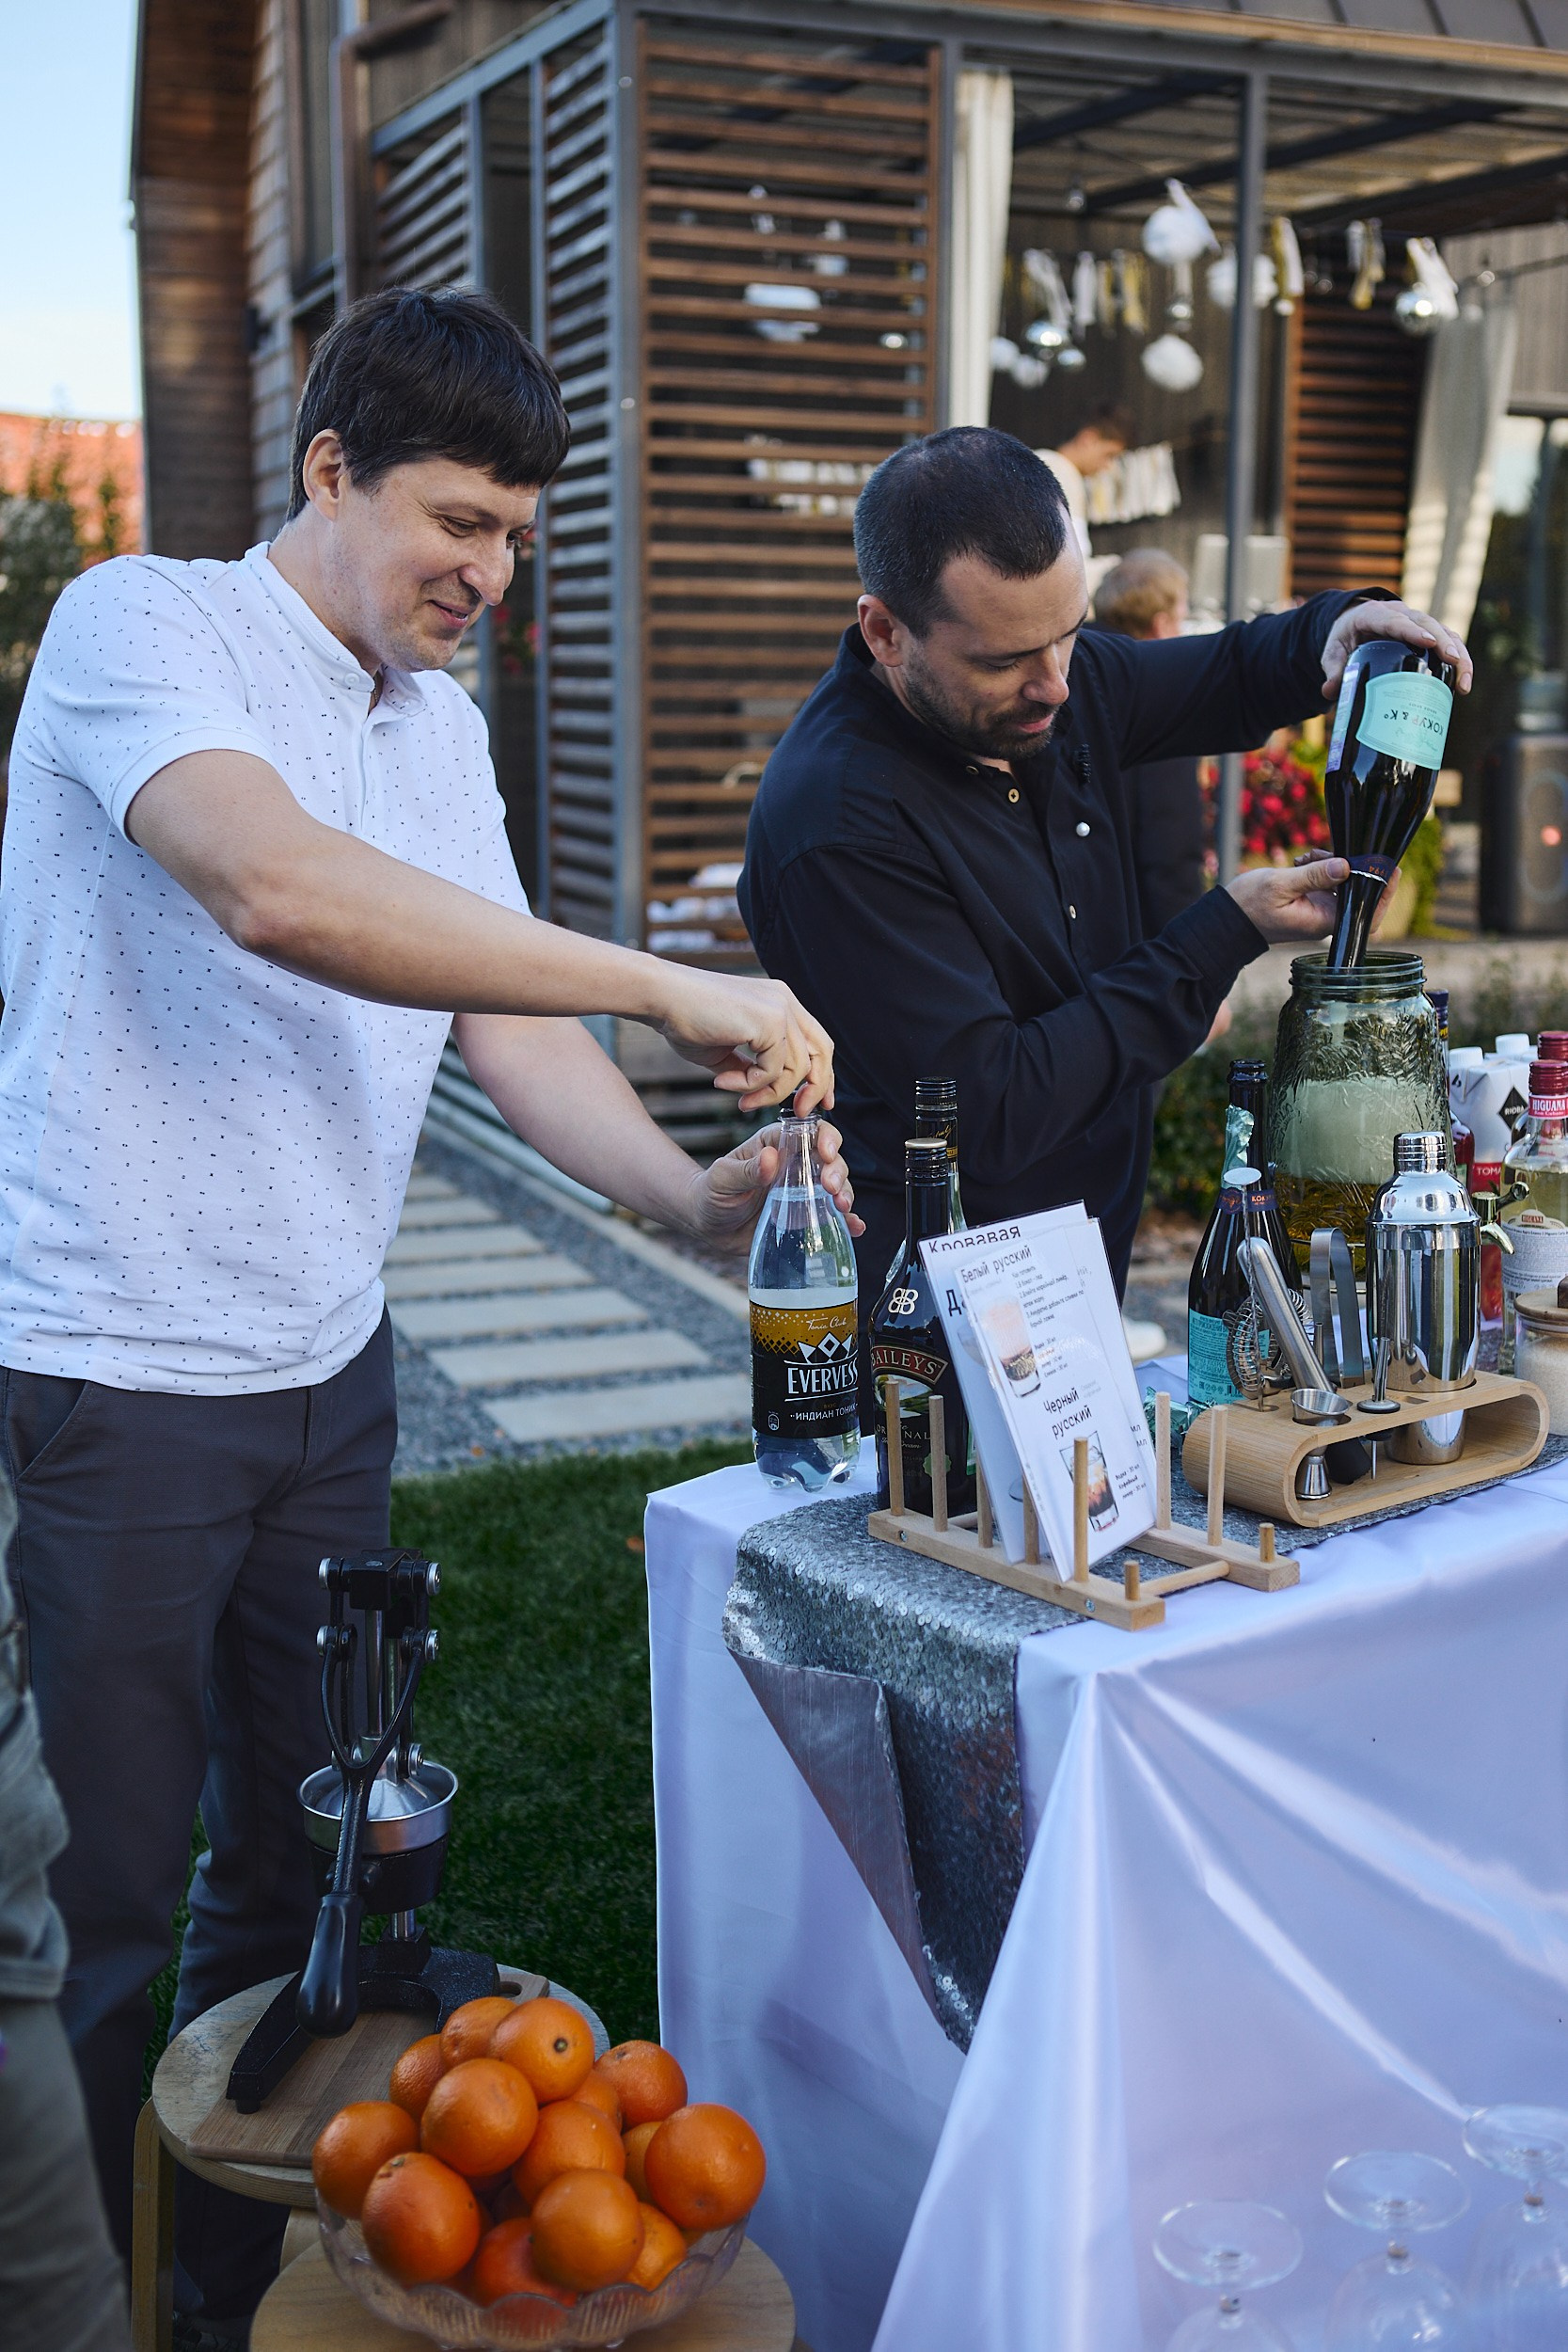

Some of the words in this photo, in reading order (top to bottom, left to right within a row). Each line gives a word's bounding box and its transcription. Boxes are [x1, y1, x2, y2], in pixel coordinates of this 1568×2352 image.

[1402, 711, 1409, 720] &
[1505, 1105, 1525, 1116] RIOBA
[1533, 1099, 1565, 1111] HIGUANA
[960, 1262, 990, 1283] Белый
[992, 1245, 1033, 1275] русский
[806, 1317, 829, 1330] Tonic
[829, 1316, 847, 1328] Club
[871, 1349, 938, 1375] BAILEYS
[787, 1357, 858, 1394] EVERVESS
[1043, 1388, 1079, 1414] Черный
[877, 1423, 931, 1440] ORNAL
[1052, 1405, 1092, 1439] русский
